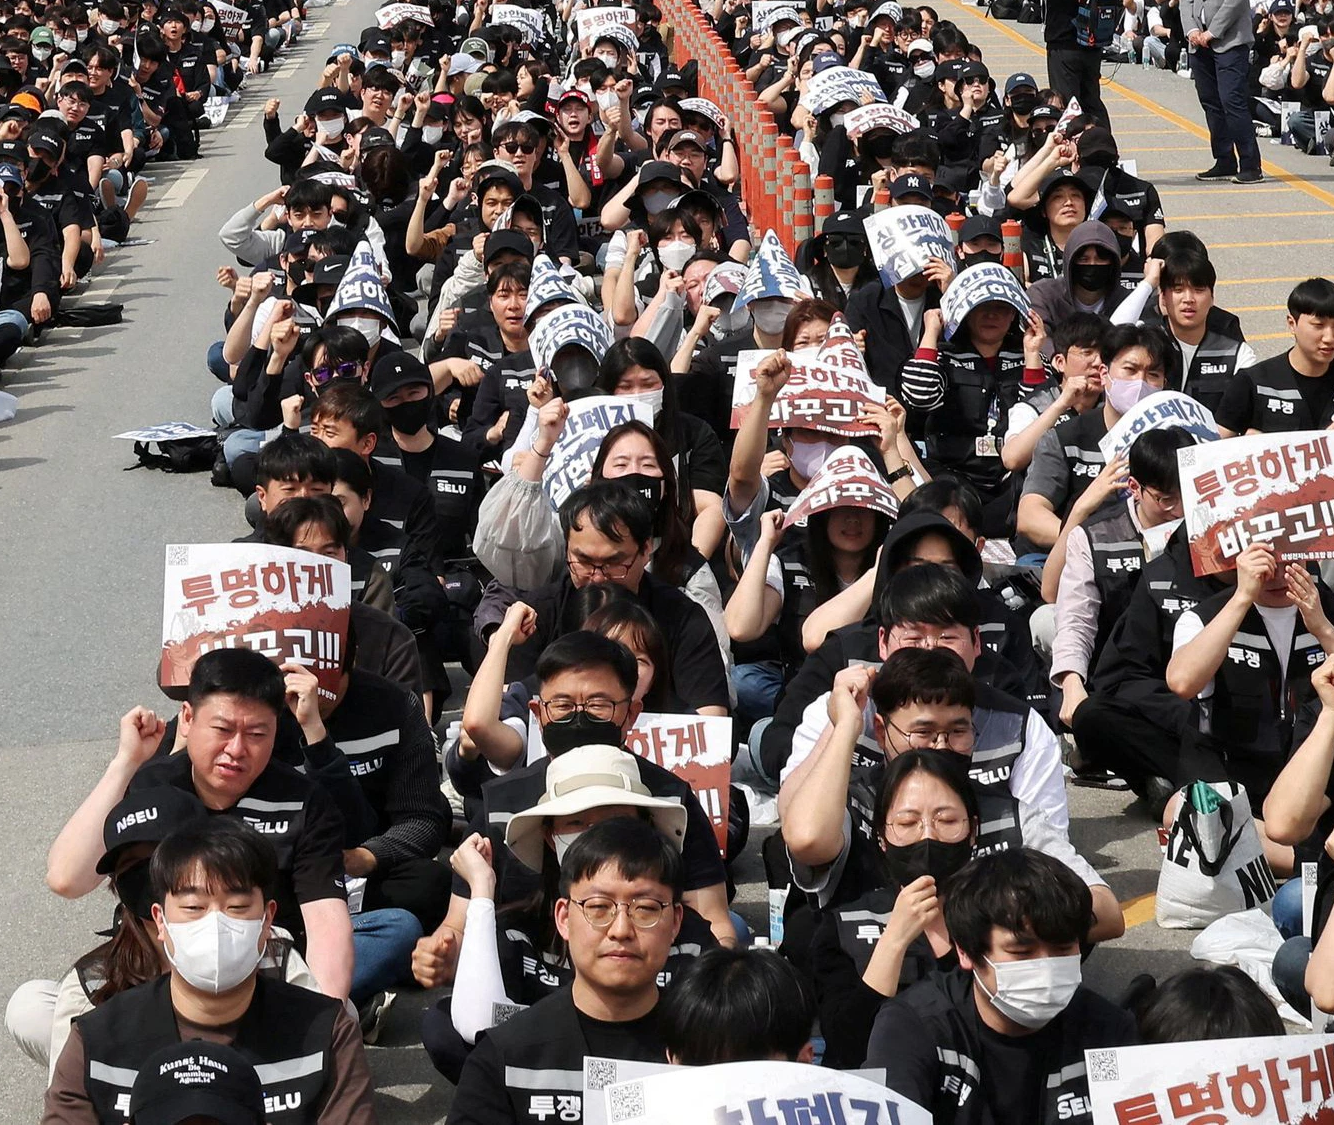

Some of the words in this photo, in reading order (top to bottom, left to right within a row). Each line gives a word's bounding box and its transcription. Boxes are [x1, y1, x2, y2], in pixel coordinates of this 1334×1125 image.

[218, 7, 245, 23] 명하게
[497, 6, 539, 25] 상한폐지
[580, 11, 631, 28] 투명하게
[907, 176, 920, 188] NY
[877, 215, 948, 251] 상한폐지
[749, 364, 869, 393] 명하게
[1200, 363, 1228, 375] SELU
[505, 378, 532, 391] 투쟁
[768, 397, 865, 424] 바꾸고
[1267, 399, 1294, 414] 투쟁
[1193, 437, 1332, 508] 투명하게
[437, 482, 466, 494] SELU
[810, 482, 897, 509] 바꾸고
[1106, 556, 1140, 574] 투쟁
[1281, 552, 1325, 562] 삼성전자노동조합
[181, 563, 334, 616] 투명하게
[1228, 647, 1262, 669] 투쟁
[627, 722, 707, 768] 하게
[349, 756, 384, 776] SELU
[116, 807, 158, 834] NSEU
[159, 1057, 195, 1075] Kunst
[198, 1055, 229, 1074] Haus
[174, 1071, 216, 1079] Sammlung
[264, 1092, 302, 1114] ELU
[529, 1096, 582, 1121] 투쟁
